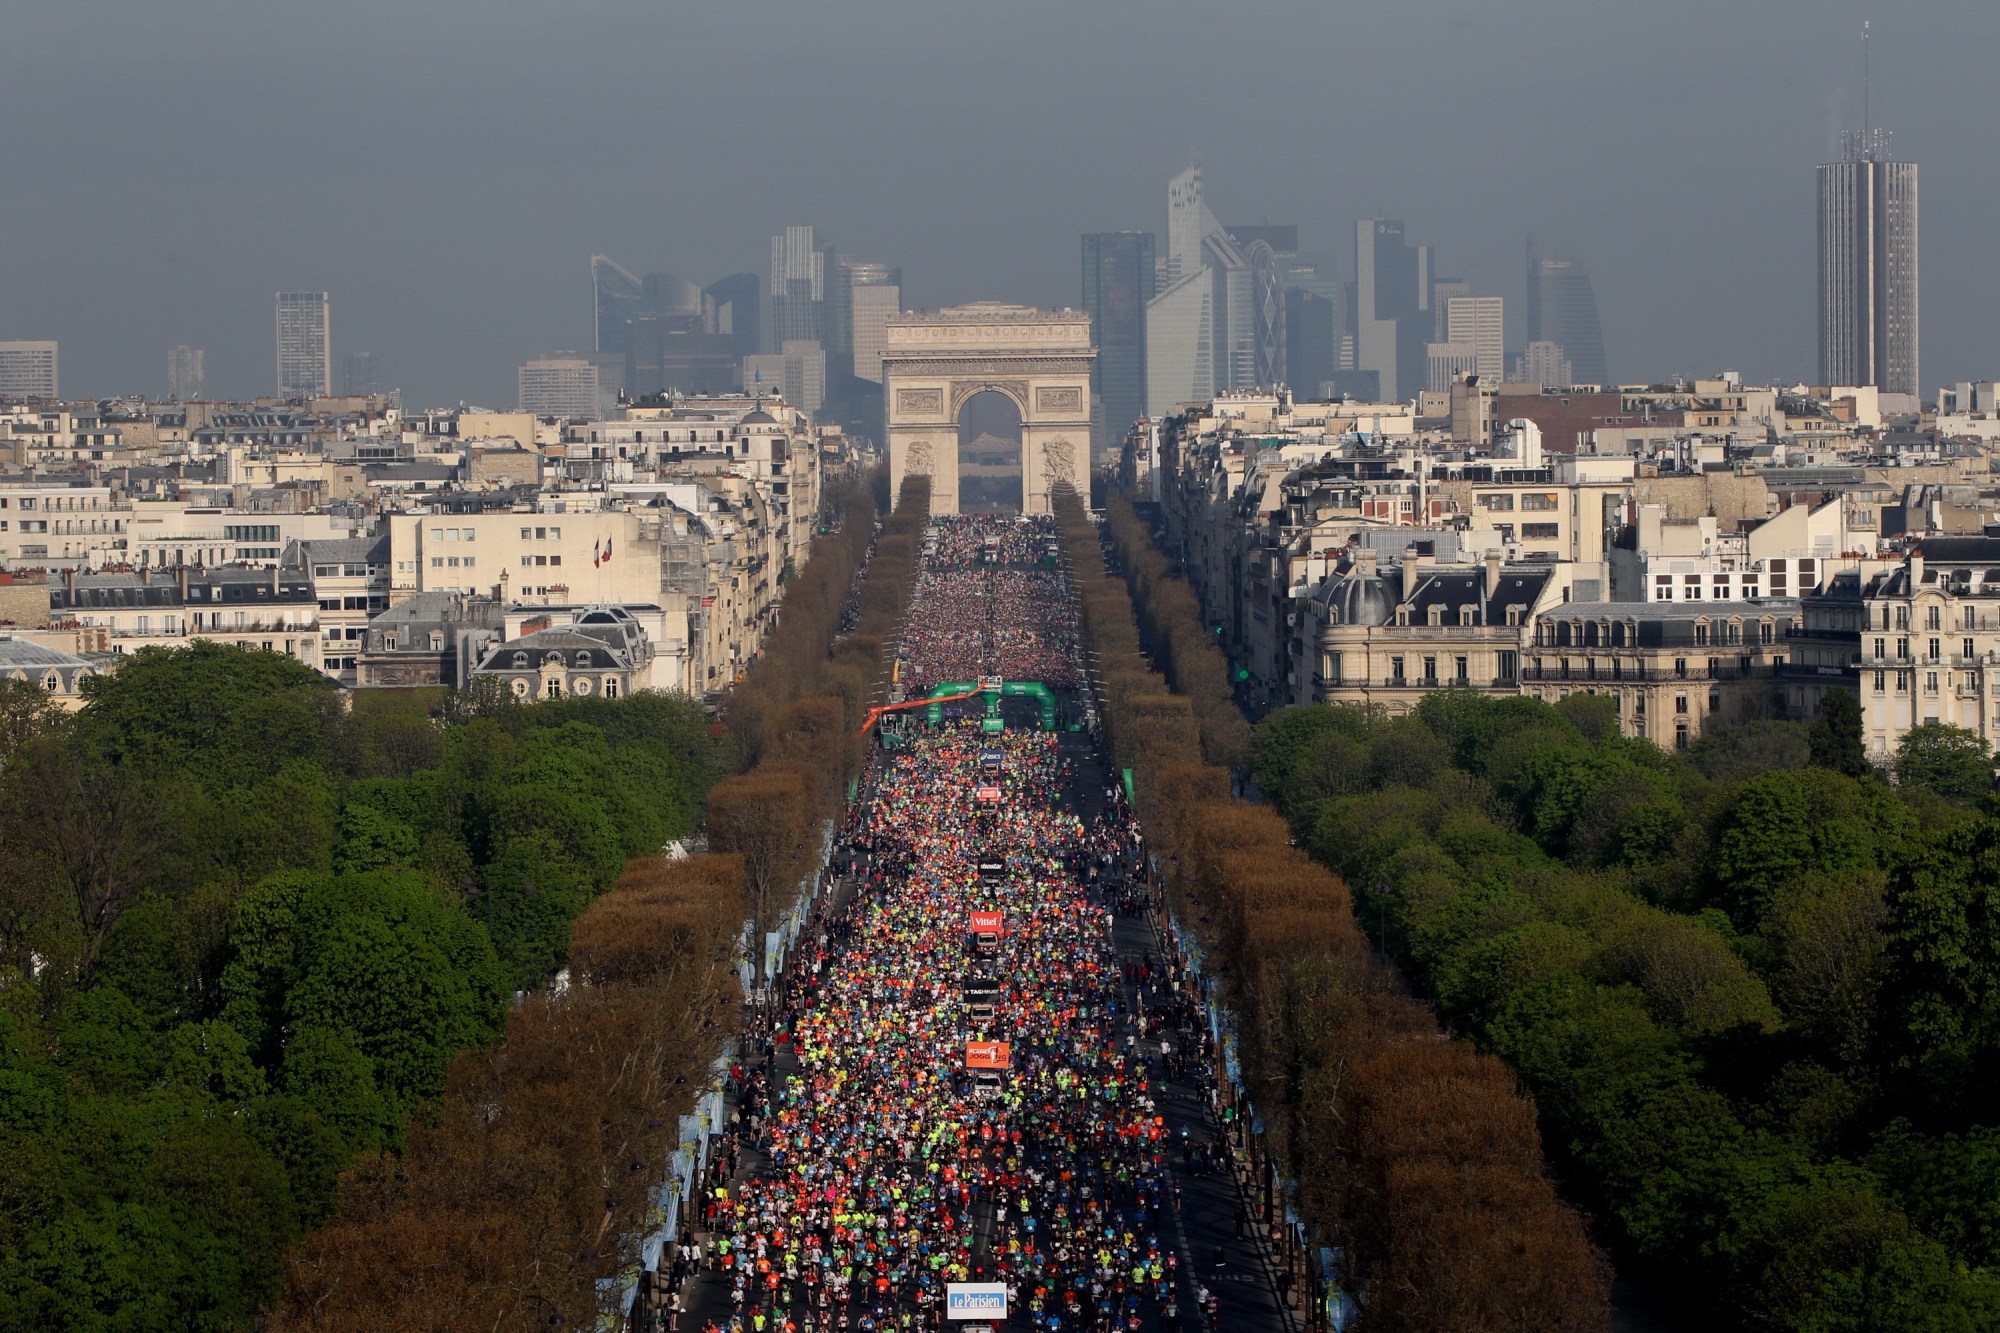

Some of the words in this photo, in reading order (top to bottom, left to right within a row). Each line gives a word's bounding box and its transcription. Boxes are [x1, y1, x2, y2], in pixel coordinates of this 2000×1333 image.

[975, 917, 997, 926] Vittel
[954, 1297, 963, 1308] Le
[964, 1293, 1000, 1308] Parisien
